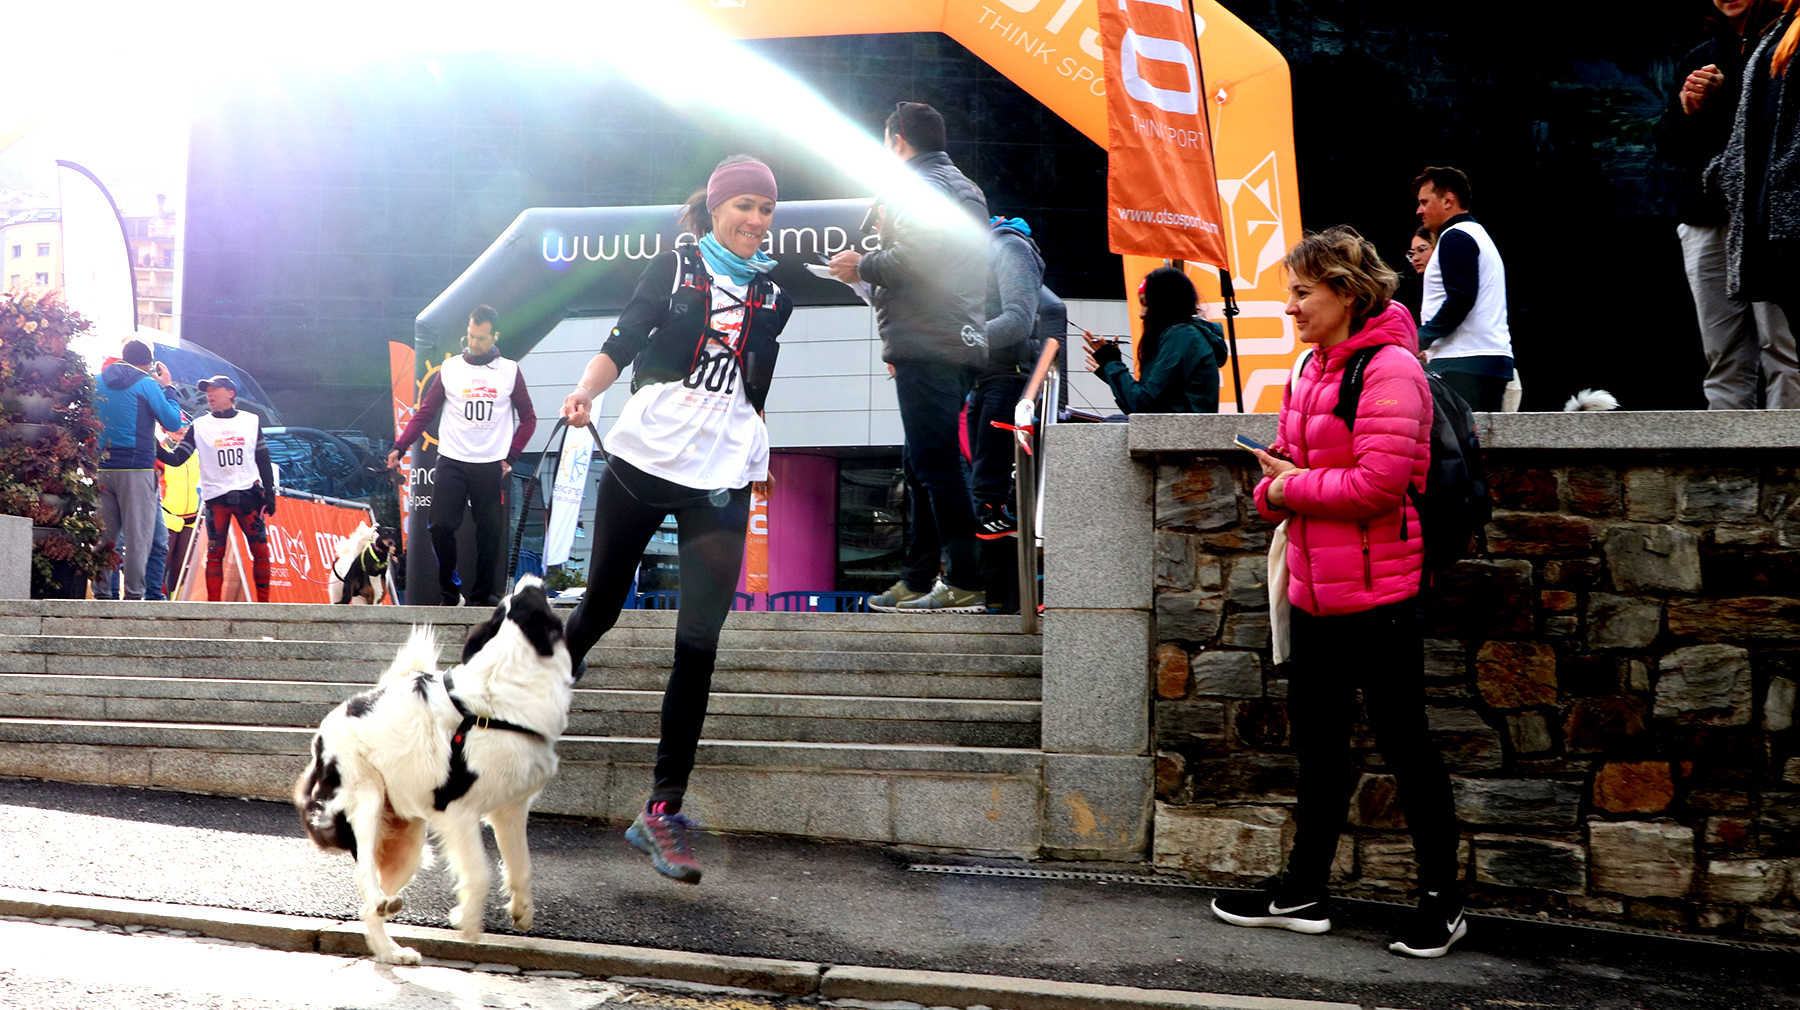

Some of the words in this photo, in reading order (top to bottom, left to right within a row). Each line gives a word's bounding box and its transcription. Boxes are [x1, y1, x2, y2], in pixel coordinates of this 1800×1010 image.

[977, 5, 1057, 65] THINK
[1056, 57, 1107, 97] SPO
[464, 400, 494, 421] 007
[217, 447, 244, 468] 008
[409, 467, 437, 486] enc
